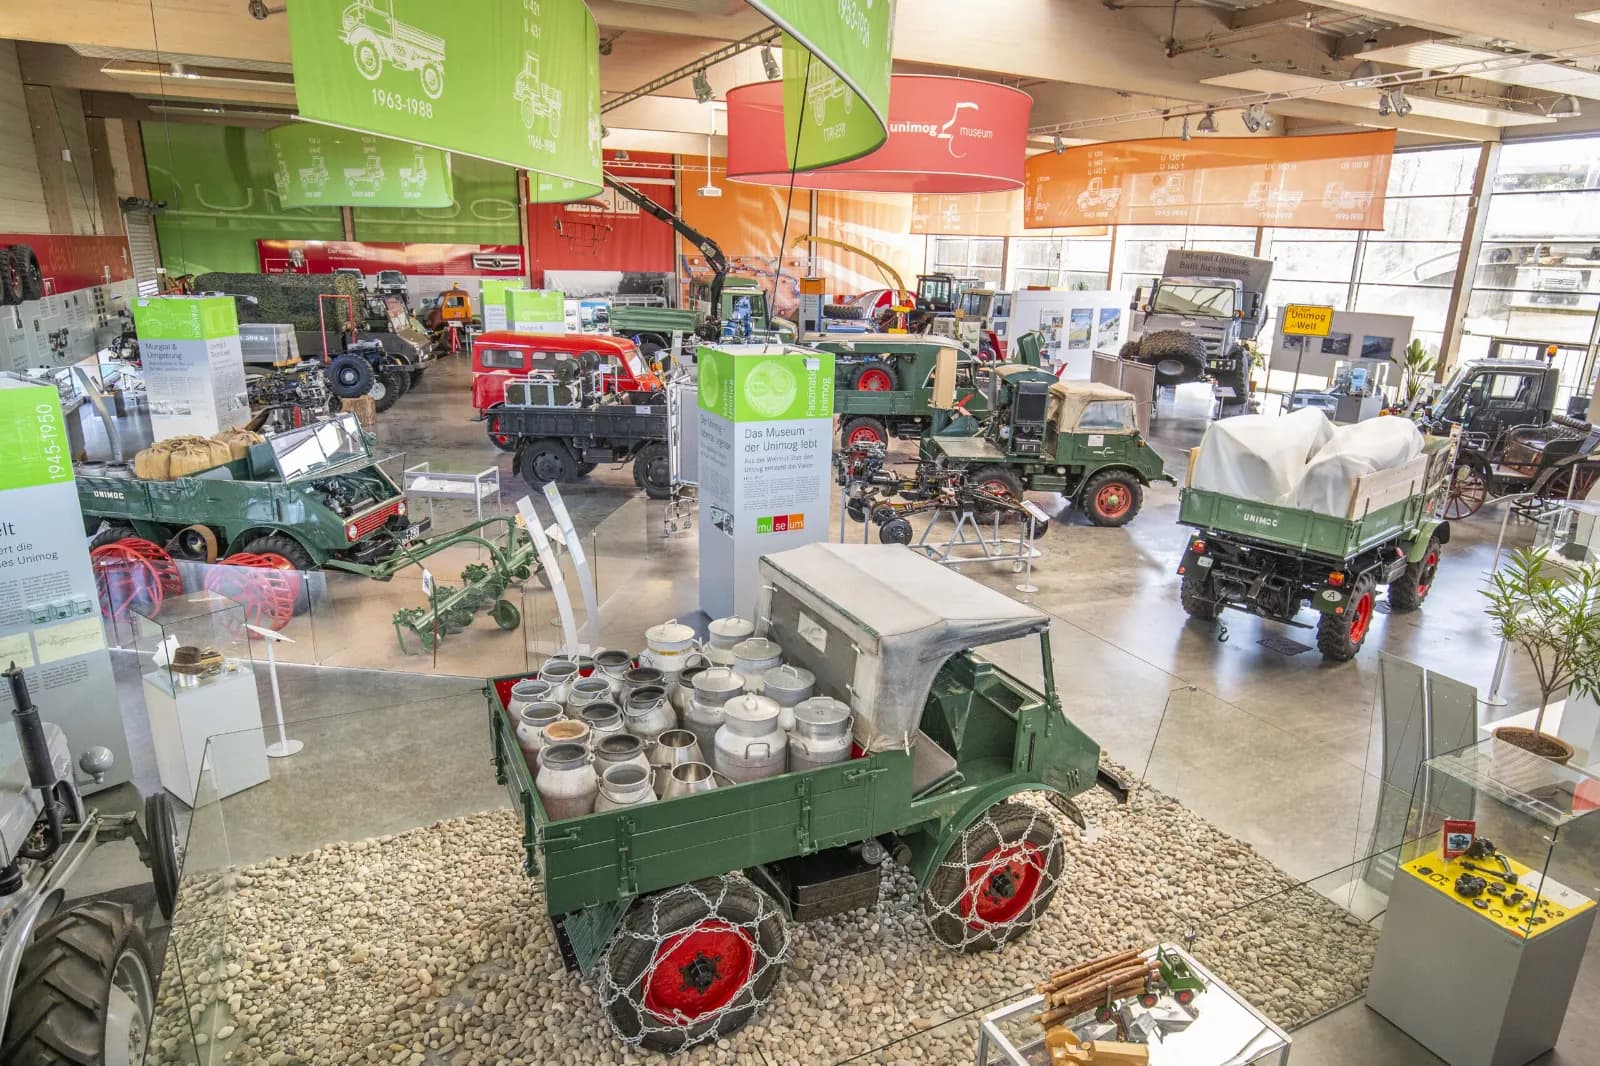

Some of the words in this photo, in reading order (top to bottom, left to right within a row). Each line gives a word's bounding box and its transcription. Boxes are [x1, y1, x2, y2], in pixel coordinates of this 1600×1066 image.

[371, 87, 433, 120] 1963-1988
[889, 121, 938, 137] unimog
[959, 126, 993, 139] museum
[1291, 310, 1326, 322] Unimog
[819, 377, 832, 416] Unimog
[744, 428, 763, 439] Das
[766, 427, 805, 438] Museum
[35, 404, 66, 480] 1945-1950
[744, 444, 760, 452] der
[763, 440, 799, 452] Unimog
[800, 439, 818, 449] lebt
[93, 490, 125, 499] UNIMOG
[1243, 513, 1278, 527] UNIMOG
[0, 522, 16, 536] lt
[17, 543, 33, 552] die
[0, 559, 14, 568] es
[17, 551, 58, 565] Unimog
[1327, 591, 1335, 601] A
